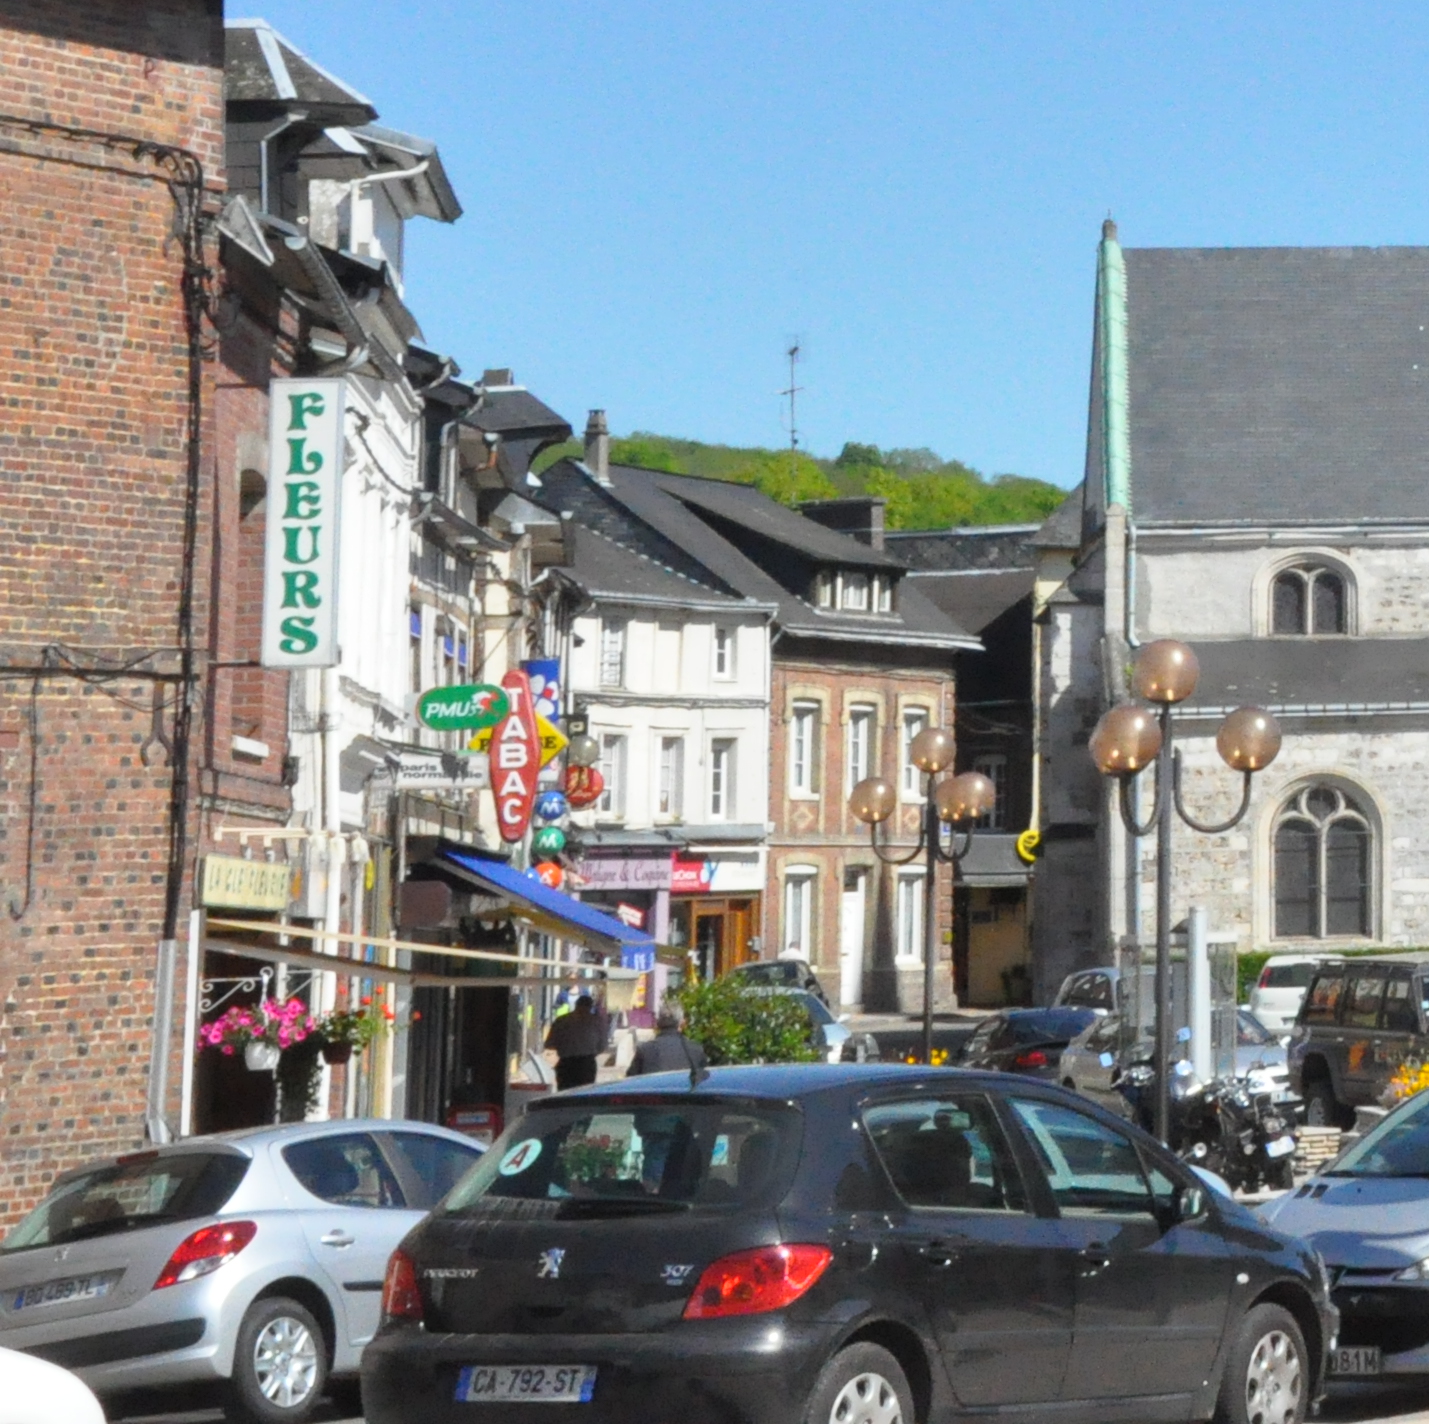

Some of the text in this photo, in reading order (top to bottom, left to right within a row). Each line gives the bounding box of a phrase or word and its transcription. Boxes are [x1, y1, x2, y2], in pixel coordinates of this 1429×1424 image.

[279, 391, 326, 656] FLEURS
[424, 701, 471, 719] PMU
[499, 687, 528, 825] TABAC
[400, 763, 438, 774] paris
[402, 770, 483, 779] normie
[504, 1144, 531, 1169] A
[423, 1268, 479, 1278] PEUGEOT
[659, 1263, 695, 1278] 307
[472, 1368, 581, 1394] CA-792-ST
